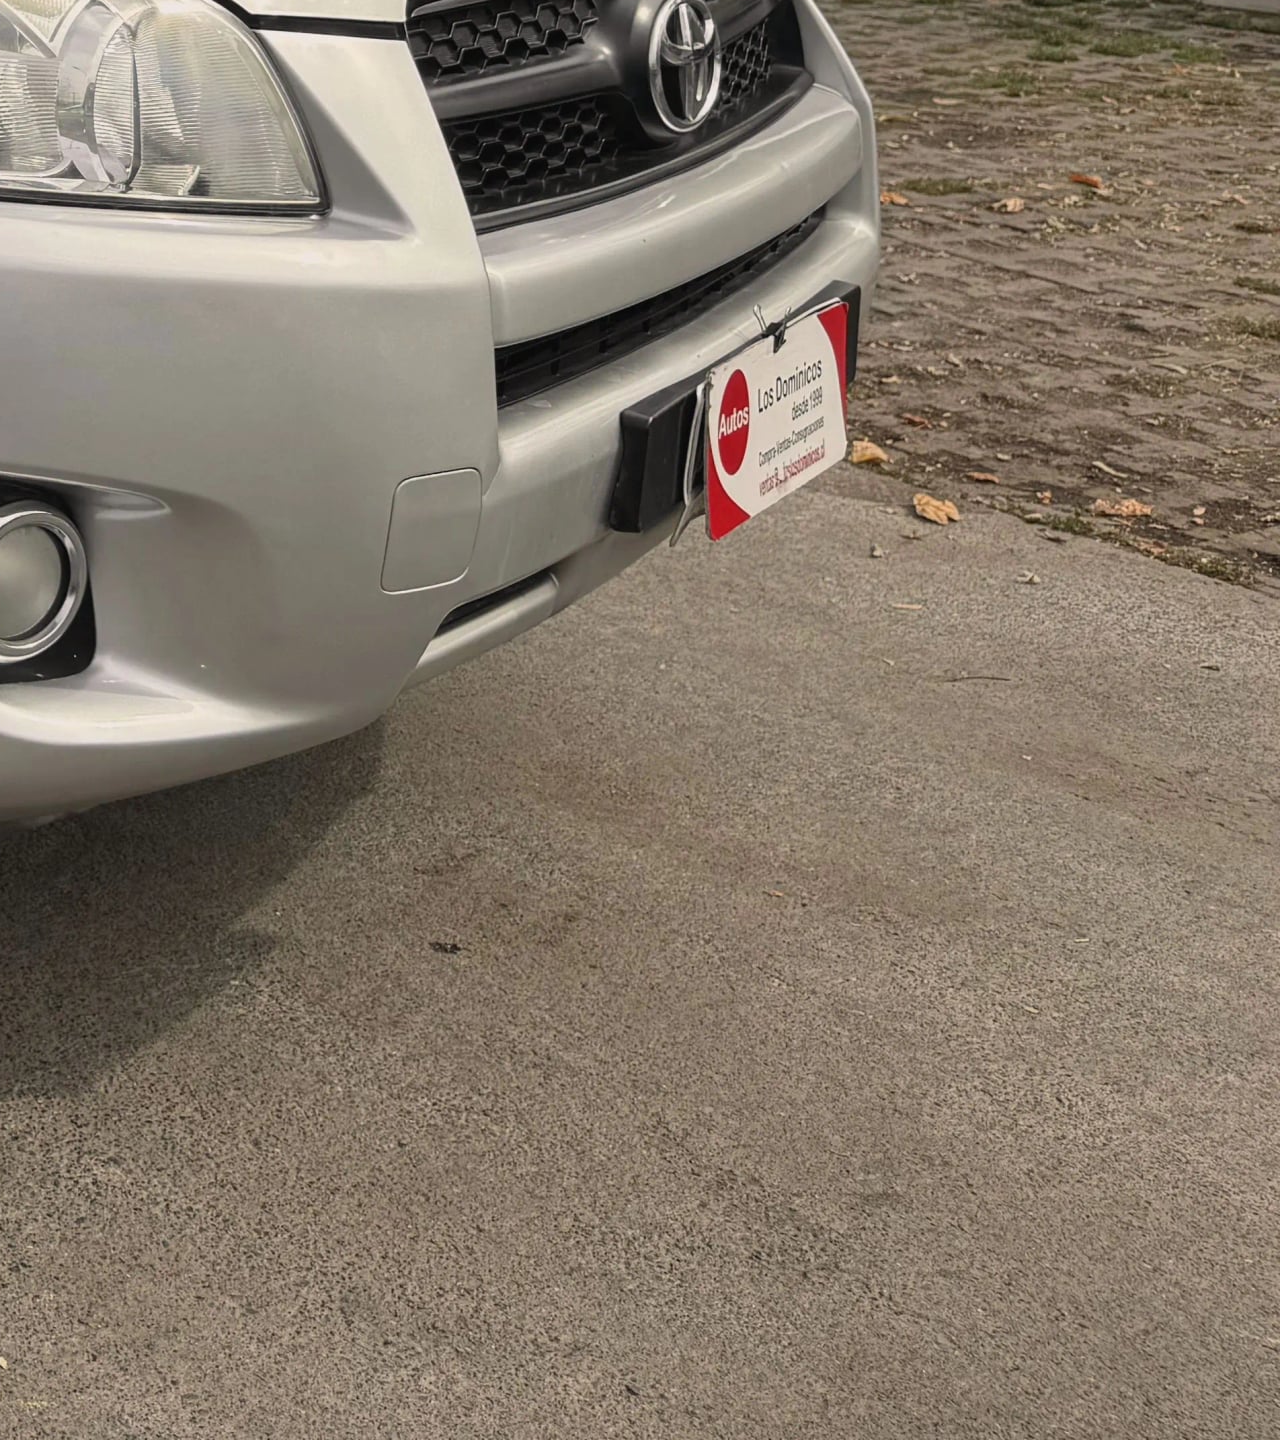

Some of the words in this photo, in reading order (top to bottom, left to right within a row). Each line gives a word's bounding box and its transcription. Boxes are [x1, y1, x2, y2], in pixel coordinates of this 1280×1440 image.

[757, 388, 775, 413] Los
[775, 359, 822, 402] Dominicos
[719, 406, 749, 439] Autos
[791, 395, 809, 421] desde
